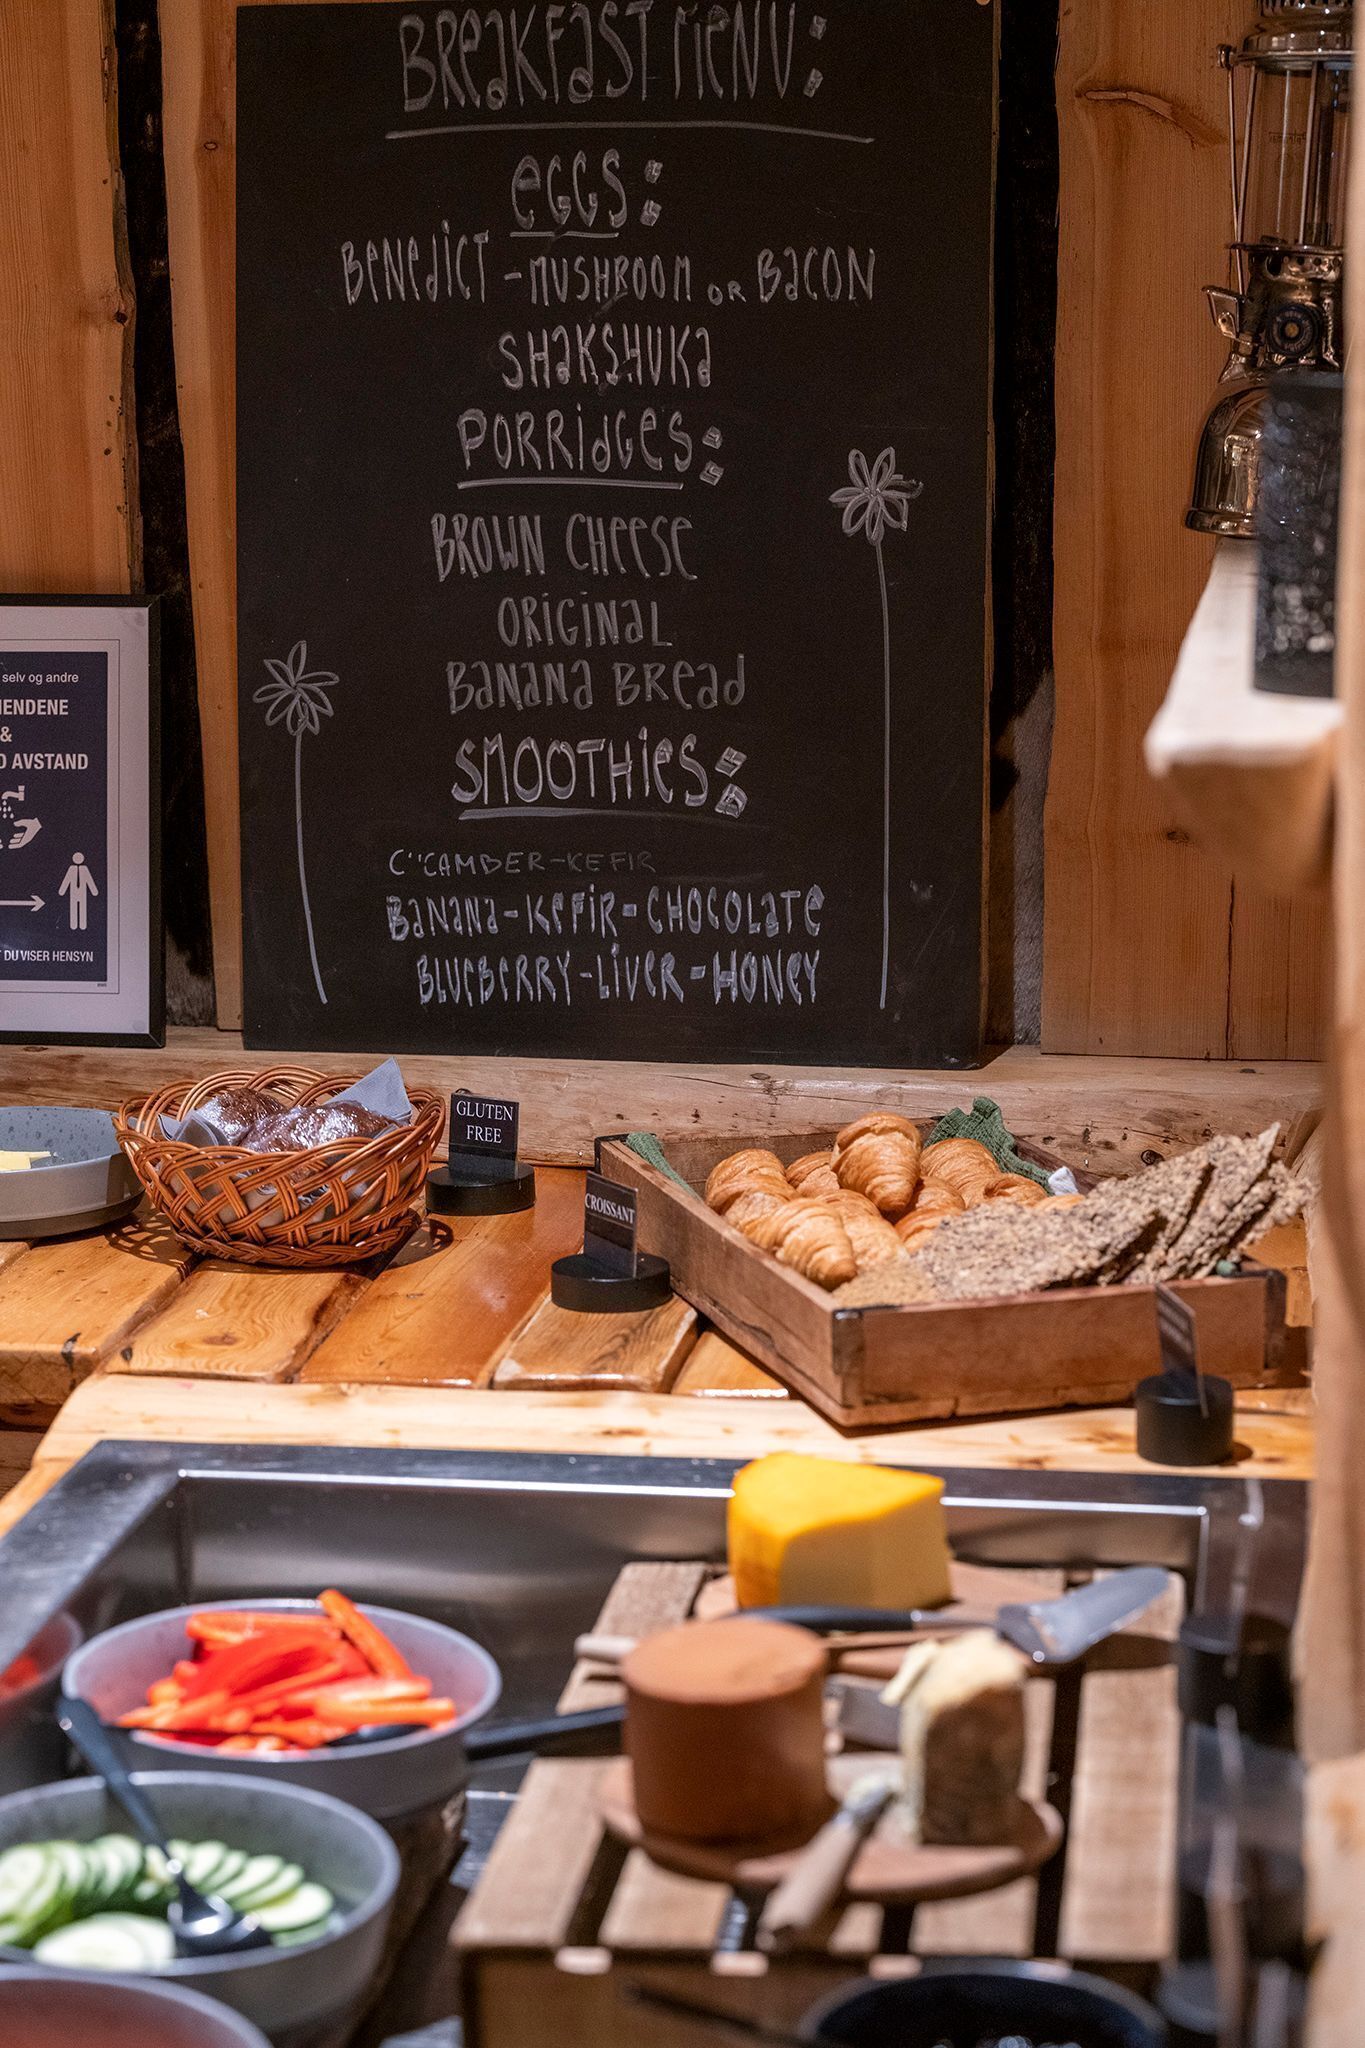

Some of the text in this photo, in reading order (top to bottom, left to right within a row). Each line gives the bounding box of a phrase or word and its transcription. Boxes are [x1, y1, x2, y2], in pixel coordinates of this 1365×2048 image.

[431, 512, 546, 582] BROWN
[2, 672, 79, 685] selv og andre
[0, 699, 69, 716] ENDENE
[0, 726, 12, 742] &
[11, 753, 89, 770] AVSTAND
[4, 950, 19, 961] DU
[20, 950, 50, 961] VISER
[52, 951, 94, 962] HENSYN
[456, 1100, 513, 1121] GLUTEN
[466, 1125, 502, 1144] FREE
[585, 1193, 635, 1224] CROISSANT
